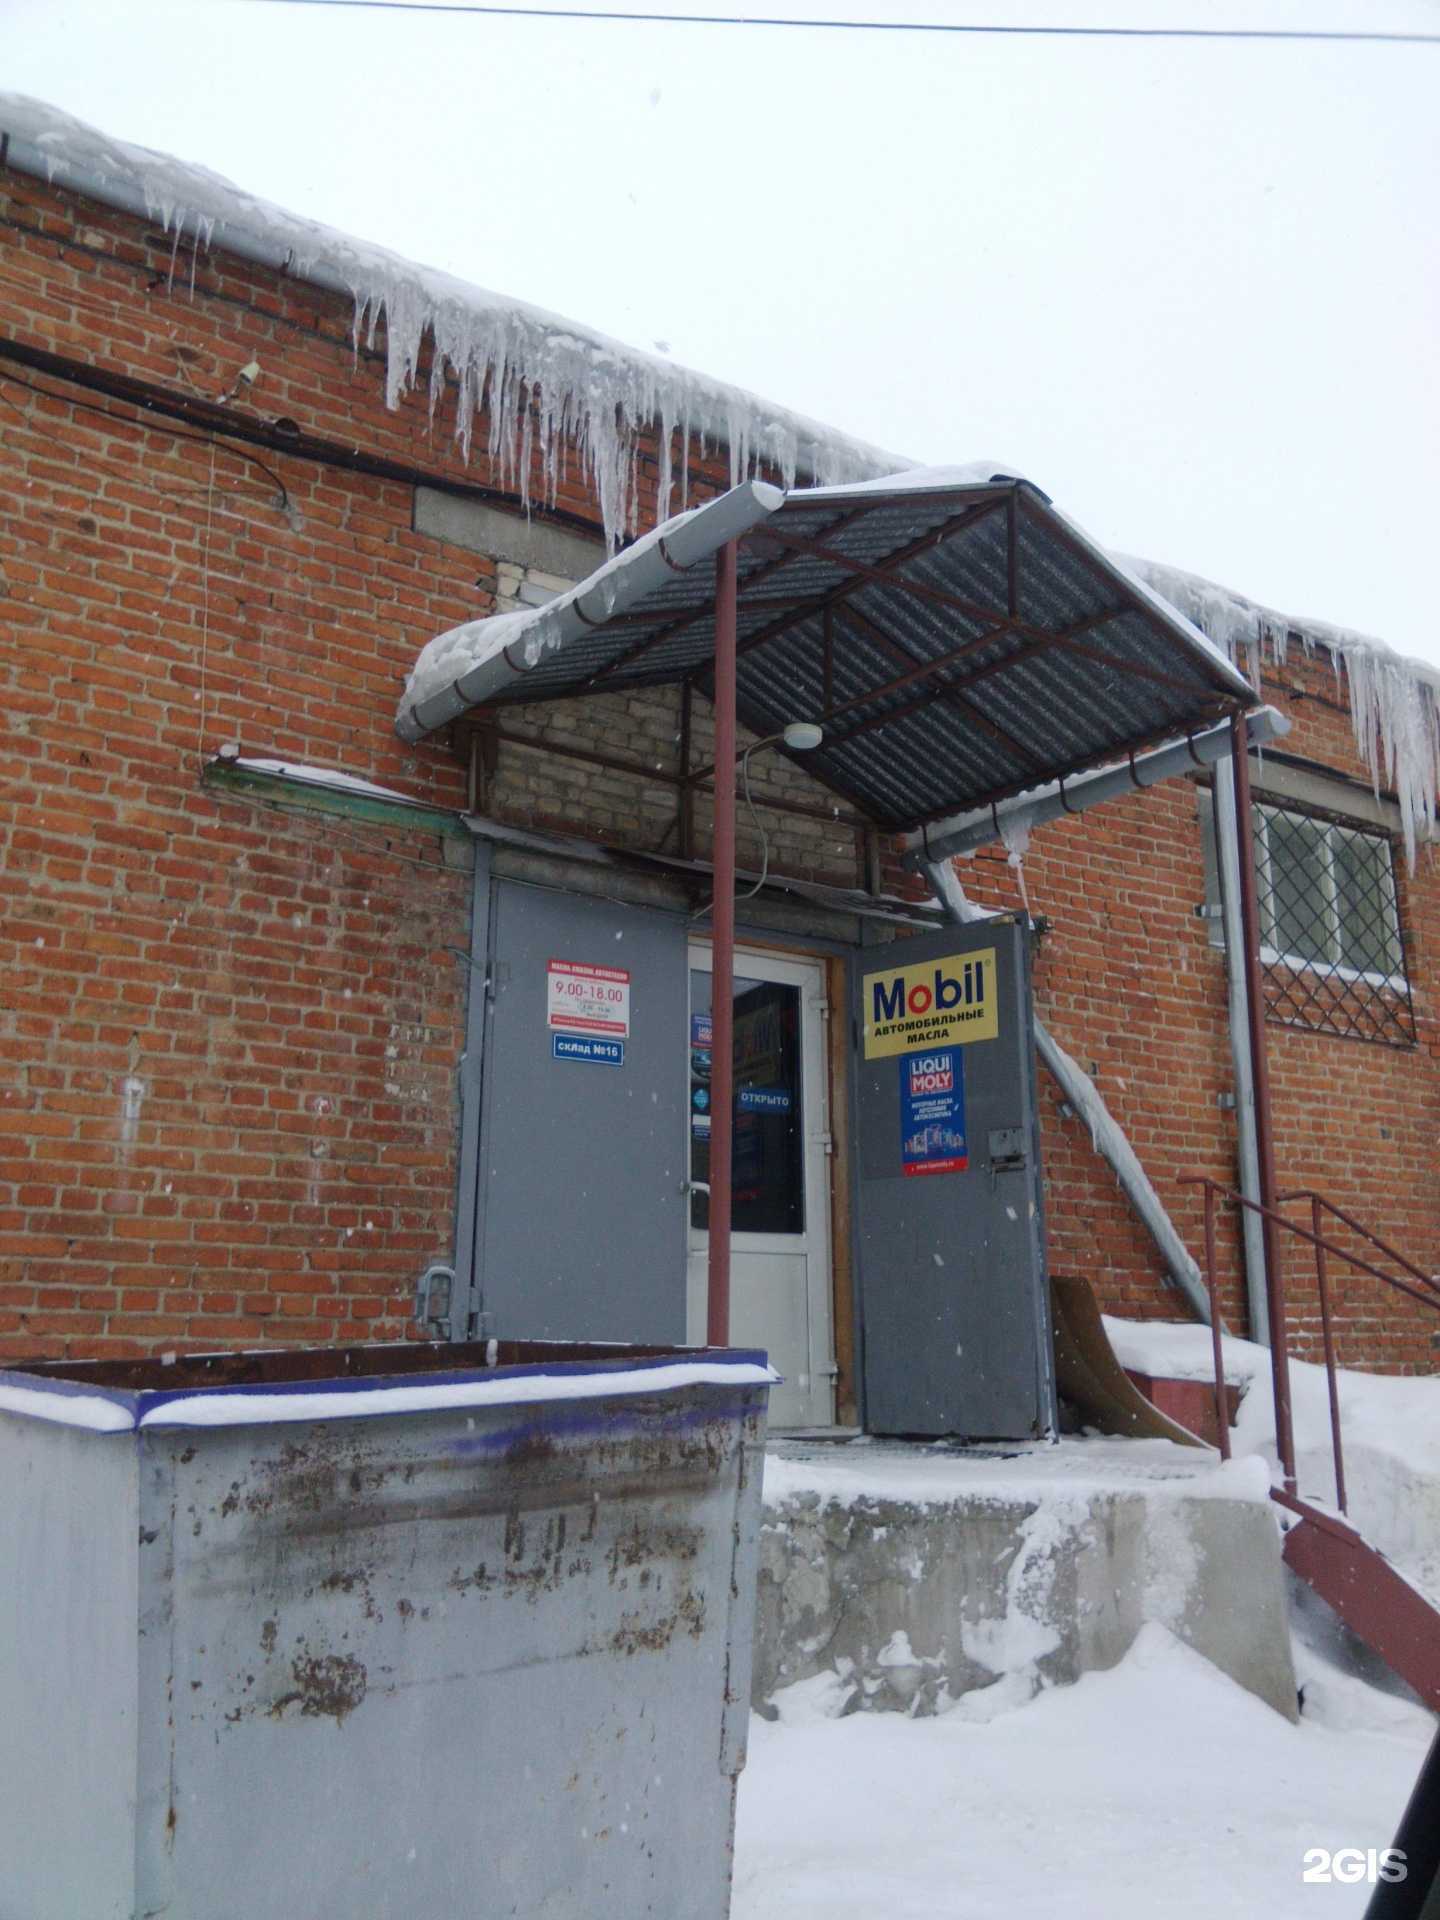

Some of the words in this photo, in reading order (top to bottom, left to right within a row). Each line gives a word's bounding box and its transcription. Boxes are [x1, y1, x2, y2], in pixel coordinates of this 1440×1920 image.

[555, 980, 623, 1002] 9.00-18.00
[873, 961, 984, 1022] Mobil
[874, 1008, 985, 1037] АВТОМОБИЛЬНЫЕ
[907, 1028, 949, 1044] МАСЛА
[558, 1042, 591, 1056] склад
[593, 1044, 618, 1057] №16
[912, 1056, 950, 1075] LIQUI
[912, 1072, 951, 1092] MOLY
[741, 1092, 789, 1106] ОТКРЫТО
